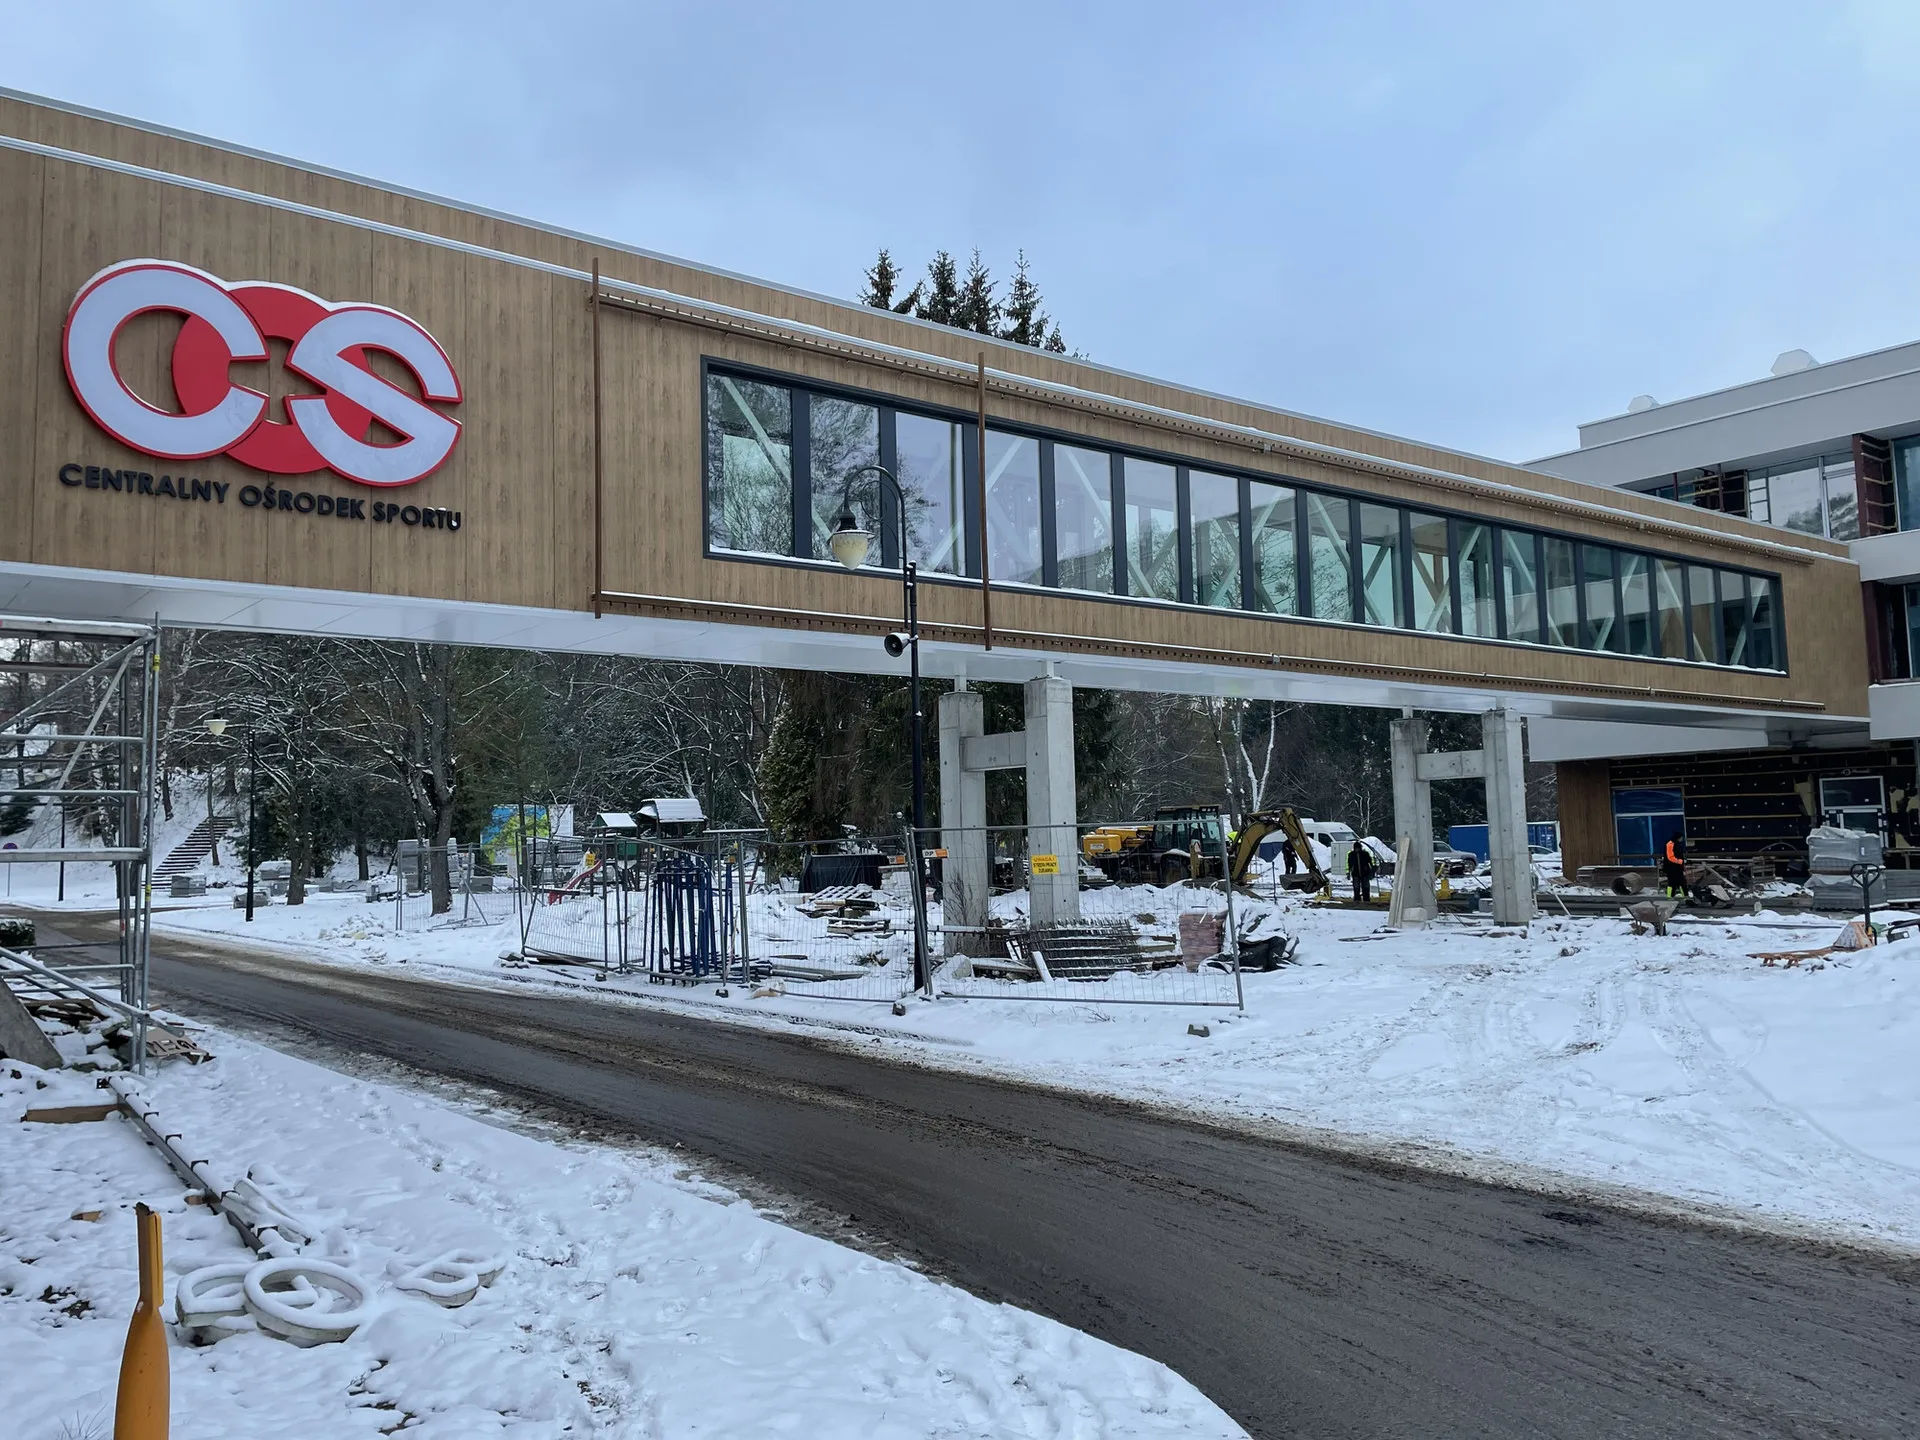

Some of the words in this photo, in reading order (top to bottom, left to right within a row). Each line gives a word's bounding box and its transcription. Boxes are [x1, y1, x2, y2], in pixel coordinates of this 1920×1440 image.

[59, 463, 230, 503] CENTRALNY
[239, 481, 366, 520] OŚRODEK
[372, 501, 462, 530] SPORTU
